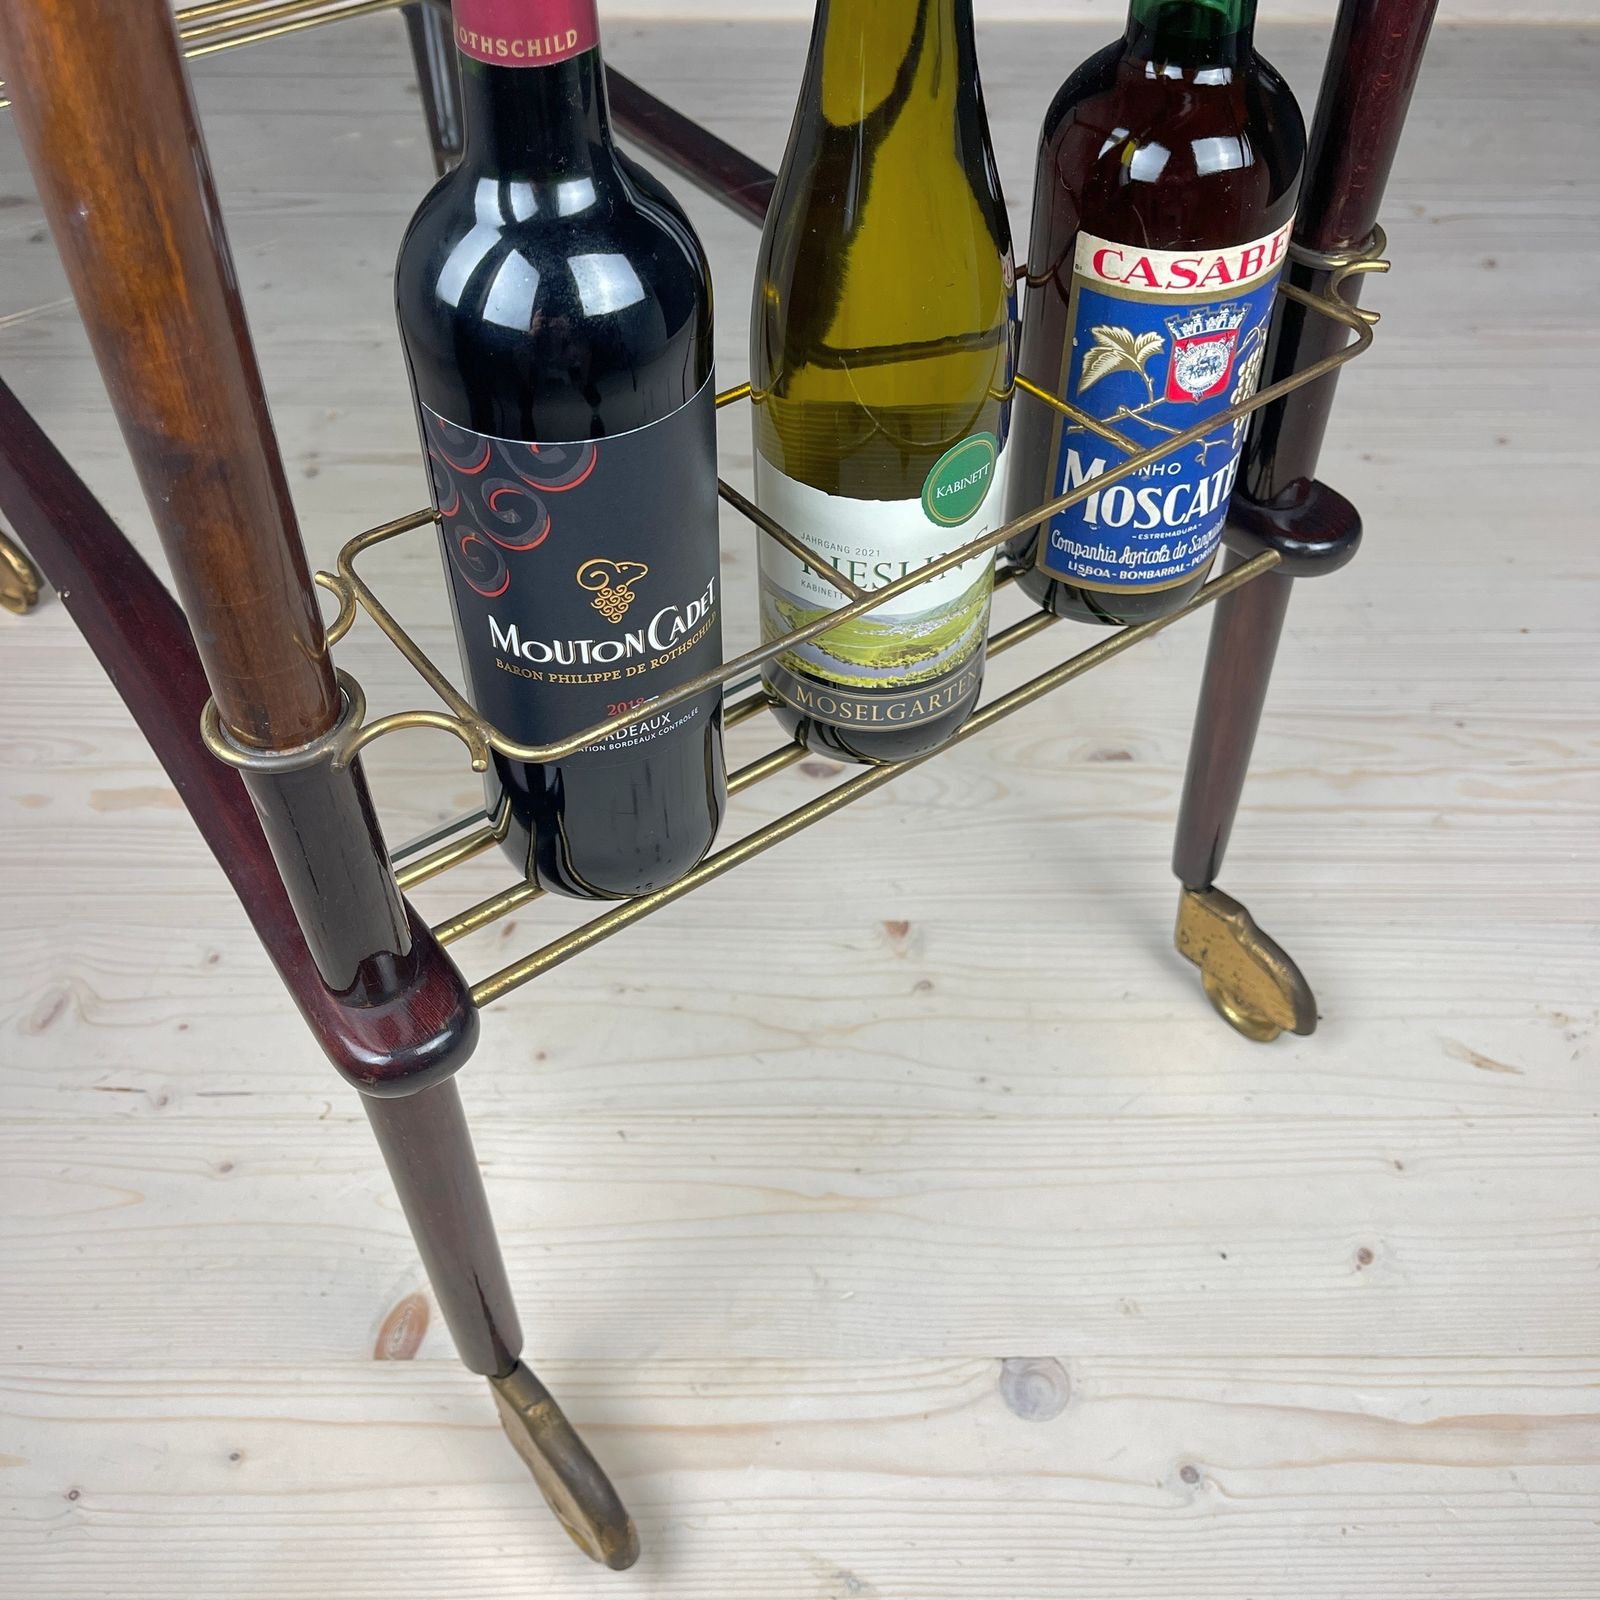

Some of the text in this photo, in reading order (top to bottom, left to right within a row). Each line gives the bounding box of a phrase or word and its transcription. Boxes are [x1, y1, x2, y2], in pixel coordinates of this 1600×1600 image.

[935, 462, 991, 500] KABINETT
[1119, 461, 1182, 477] NHO
[801, 532, 880, 557] JAHRGANG 2021
[1051, 529, 1118, 565] Companhia
[1067, 560, 1111, 579] LISBOA
[1119, 563, 1186, 580] BOMBARRAL
[800, 579, 844, 600] KABINETT
[487, 576, 716, 665] MOUTON CADET
[496, 610, 717, 684] BARON PHILIPPE DE ROTHSCHILD
[795, 671, 977, 722] MOSELGARTEN
[609, 732, 656, 750] BORDEAUX
